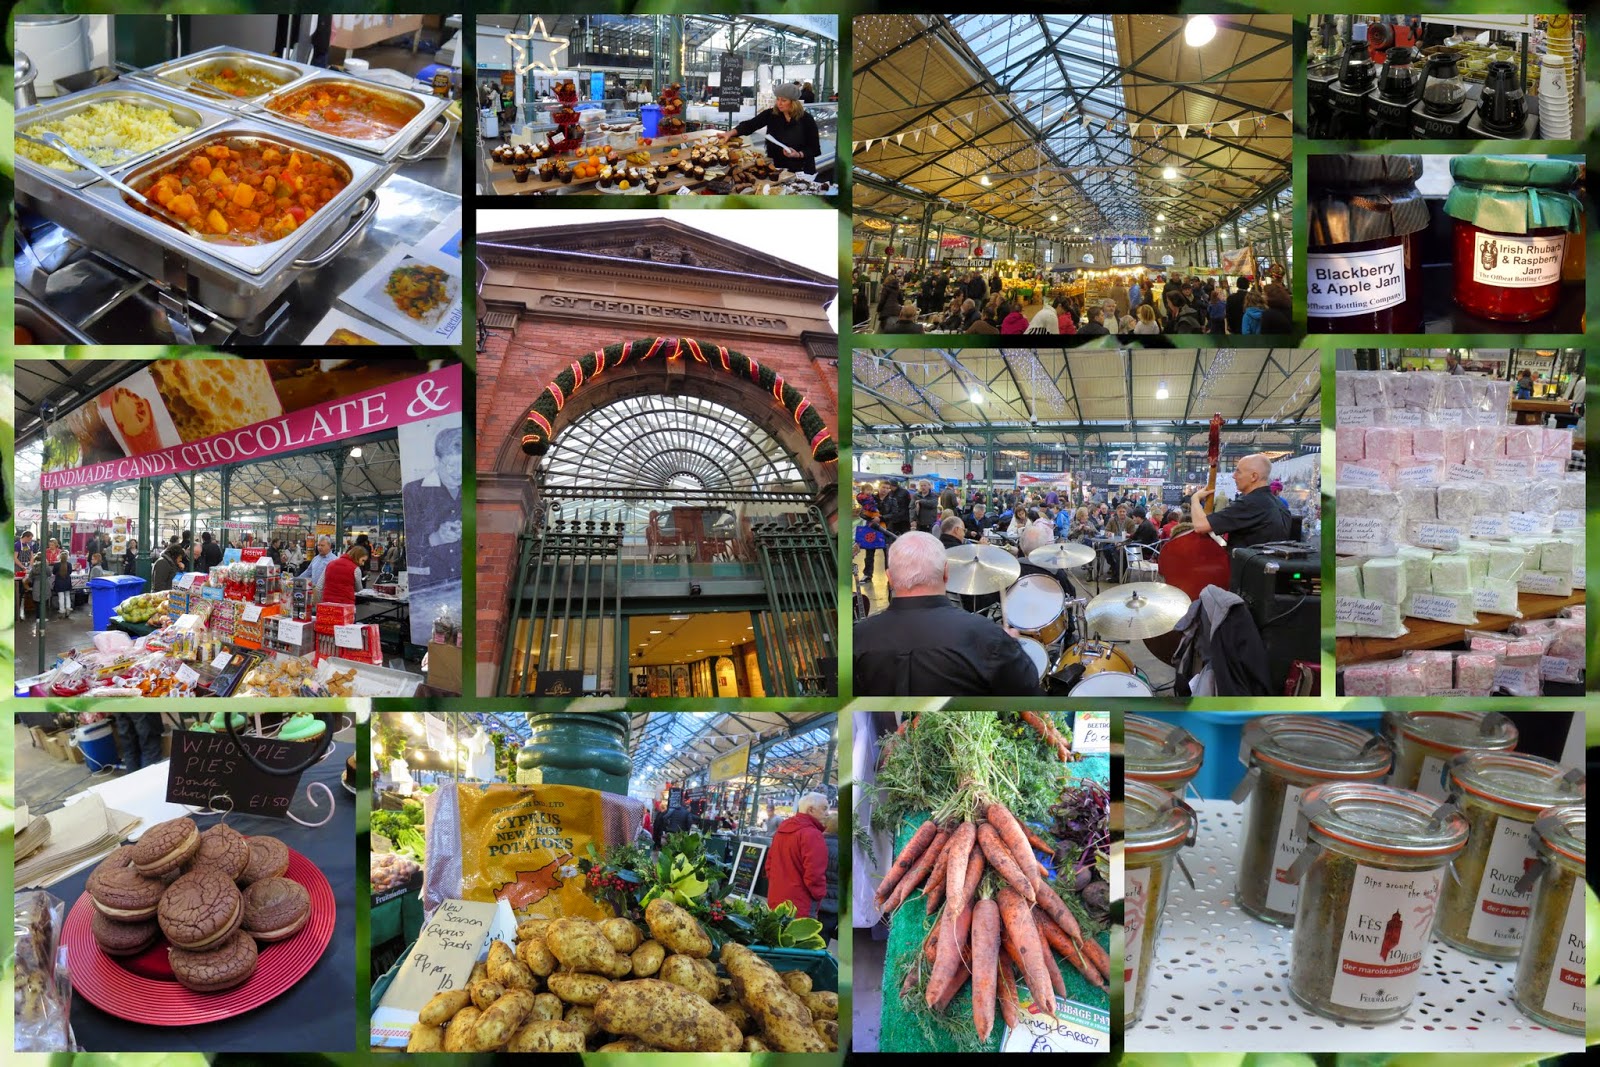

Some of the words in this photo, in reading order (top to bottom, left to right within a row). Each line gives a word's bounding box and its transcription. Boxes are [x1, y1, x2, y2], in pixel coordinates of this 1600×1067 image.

[1425, 121, 1454, 135] novo
[1500, 244, 1523, 255] Irish
[1527, 244, 1562, 255] Rhubarb
[1502, 256, 1510, 265] &
[1513, 255, 1559, 268] Raspberry
[1315, 262, 1395, 281] Blackberry
[1491, 273, 1513, 282] Offbeat
[1515, 274, 1538, 282] Bottling
[1522, 267, 1542, 275] Jam
[1311, 282, 1322, 294] &
[1327, 281, 1371, 297] Apple
[1375, 275, 1401, 289] Jam
[1336, 299, 1368, 311] Bottling
[1369, 292, 1401, 306] Company
[589, 299, 693, 320] GEORGE'S
[699, 310, 784, 329] MARKET
[43, 463, 115, 488] HANDMADE
[118, 450, 179, 476] CANDY
[181, 392, 389, 467] CHOCOLATE
[406, 379, 451, 418] &
[183, 735, 292, 761] WHOOPIE
[186, 756, 237, 776] PIES
[175, 776, 222, 788] Double
[497, 812, 562, 830] CYPRUS
[496, 829, 526, 843] NEW
[488, 837, 574, 857] POTATOES
[1280, 843, 1303, 855] AVAN
[1490, 868, 1520, 883] RIVER
[1125, 885, 1142, 897] orld
[1363, 876, 1382, 889] Dips
[1385, 880, 1415, 891] around
[1408, 888, 1420, 899] the
[1486, 904, 1499, 912] der
[1501, 906, 1520, 915] River
[444, 911, 483, 928] Season
[427, 923, 465, 937] Cyprus
[438, 937, 472, 952] Spuds
[1348, 930, 1380, 946] AVANT
[413, 953, 432, 973] 99p
[429, 964, 447, 976] per
[1343, 962, 1357, 972] der
[1358, 964, 1412, 976] marokkanische
[437, 973, 453, 990] lb
[1564, 974, 1579, 983] der
[1055, 1002, 1092, 1021] ABBAGE
[1057, 1024, 1099, 1049] CARROT
